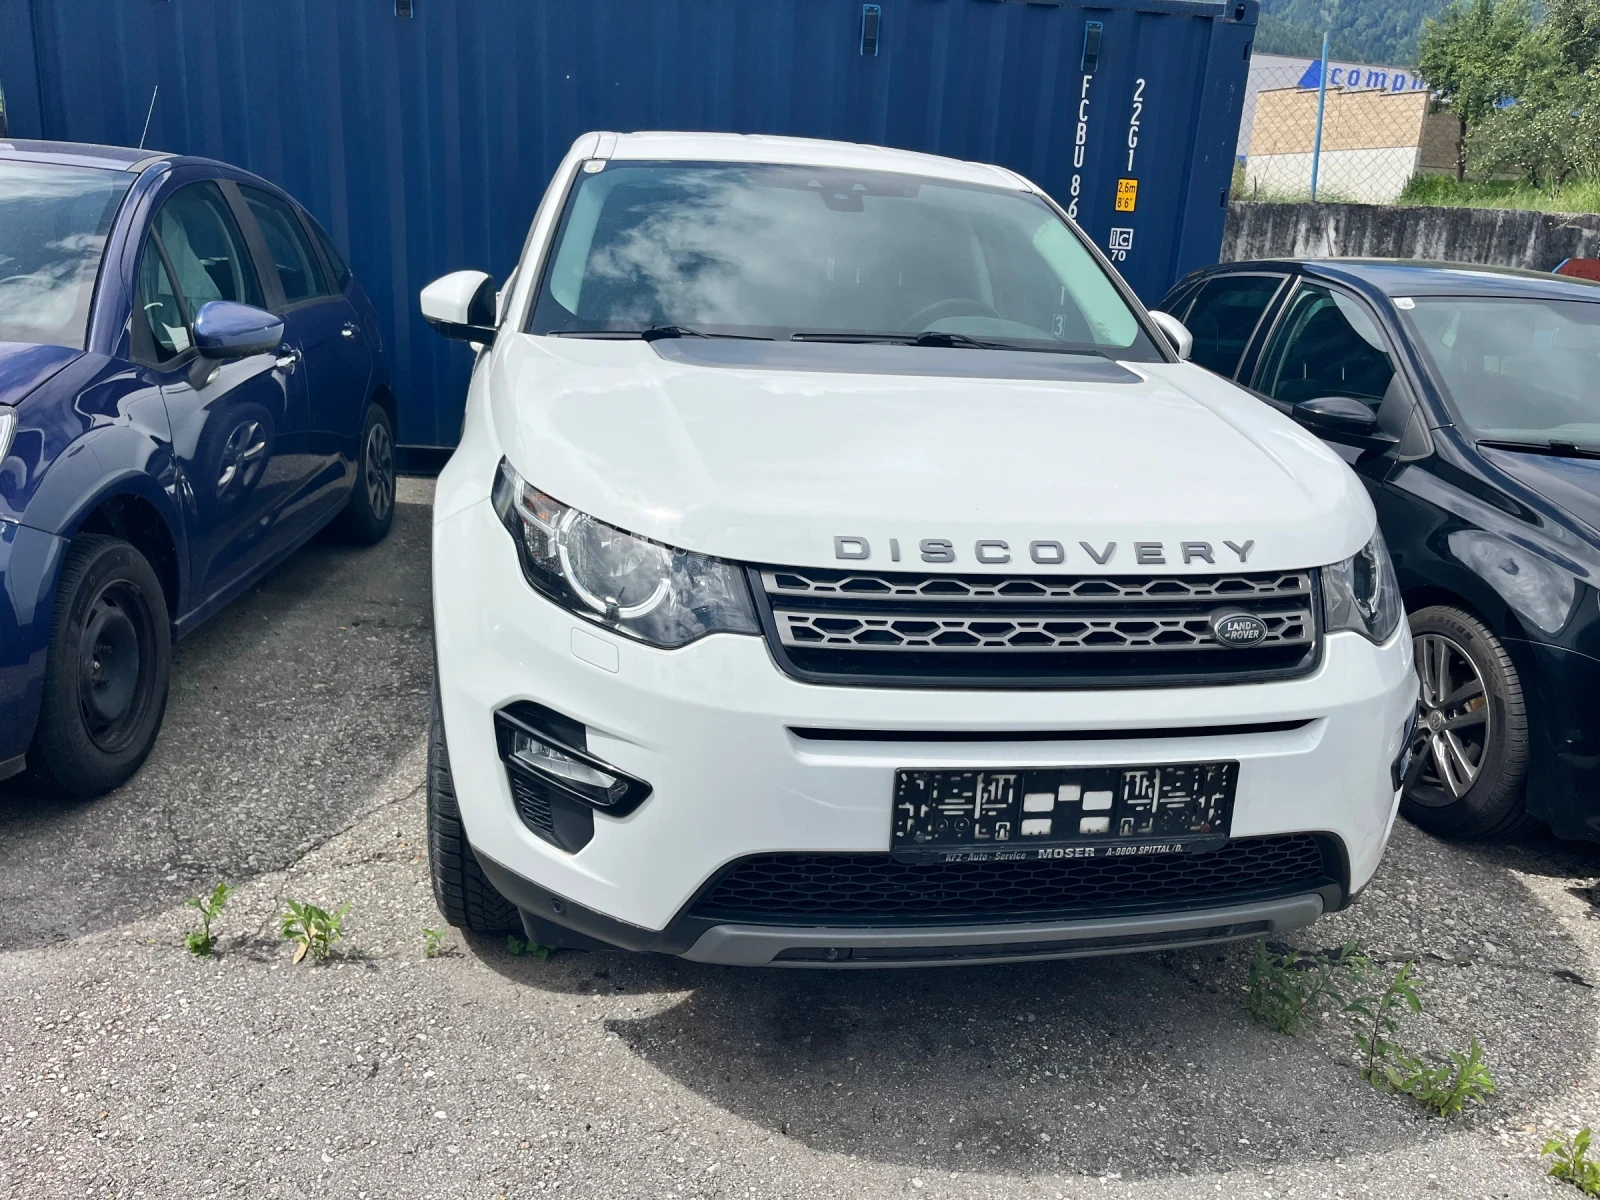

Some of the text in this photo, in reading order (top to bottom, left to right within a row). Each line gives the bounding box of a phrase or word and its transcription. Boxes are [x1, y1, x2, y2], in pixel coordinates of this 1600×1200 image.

[1073, 75, 1093, 168] FCBU
[1127, 78, 1146, 172] 22G1
[1111, 250, 1127, 262] 70
[833, 535, 1255, 565] DISCOVERY
[1227, 621, 1251, 631] LAND
[1230, 629, 1260, 640] ROVER
[1037, 847, 1095, 858] MOSER
[1105, 847, 1137, 857] A-9800
